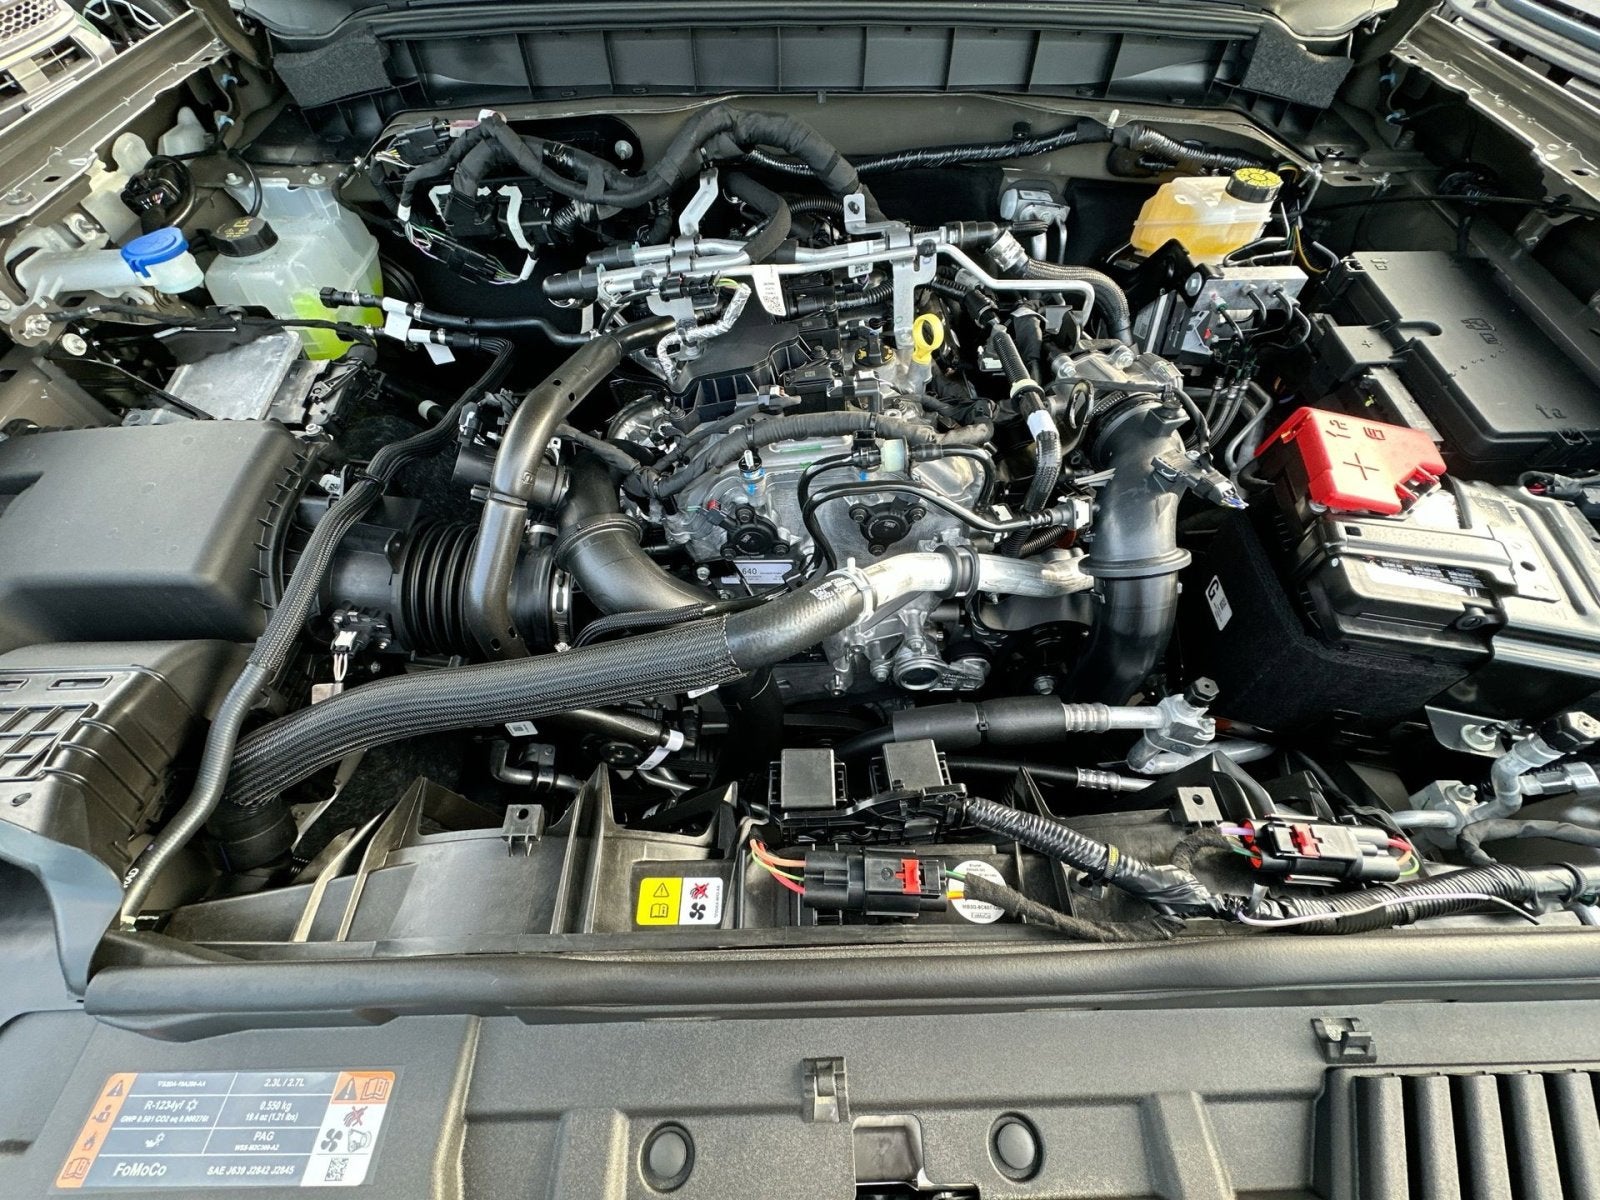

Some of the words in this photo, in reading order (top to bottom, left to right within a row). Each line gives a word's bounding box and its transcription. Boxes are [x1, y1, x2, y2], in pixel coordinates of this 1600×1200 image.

[1208, 579, 1219, 601] G
[264, 1078, 281, 1087] 2.3L
[287, 1078, 304, 1087] 2.7L
[144, 1100, 185, 1112] R-1234yf
[260, 1101, 280, 1111] 0.550
[281, 1101, 292, 1112] kg
[253, 1131, 275, 1141] PAG
[113, 1162, 167, 1177] FoMoCo
[207, 1166, 226, 1175] SAE
